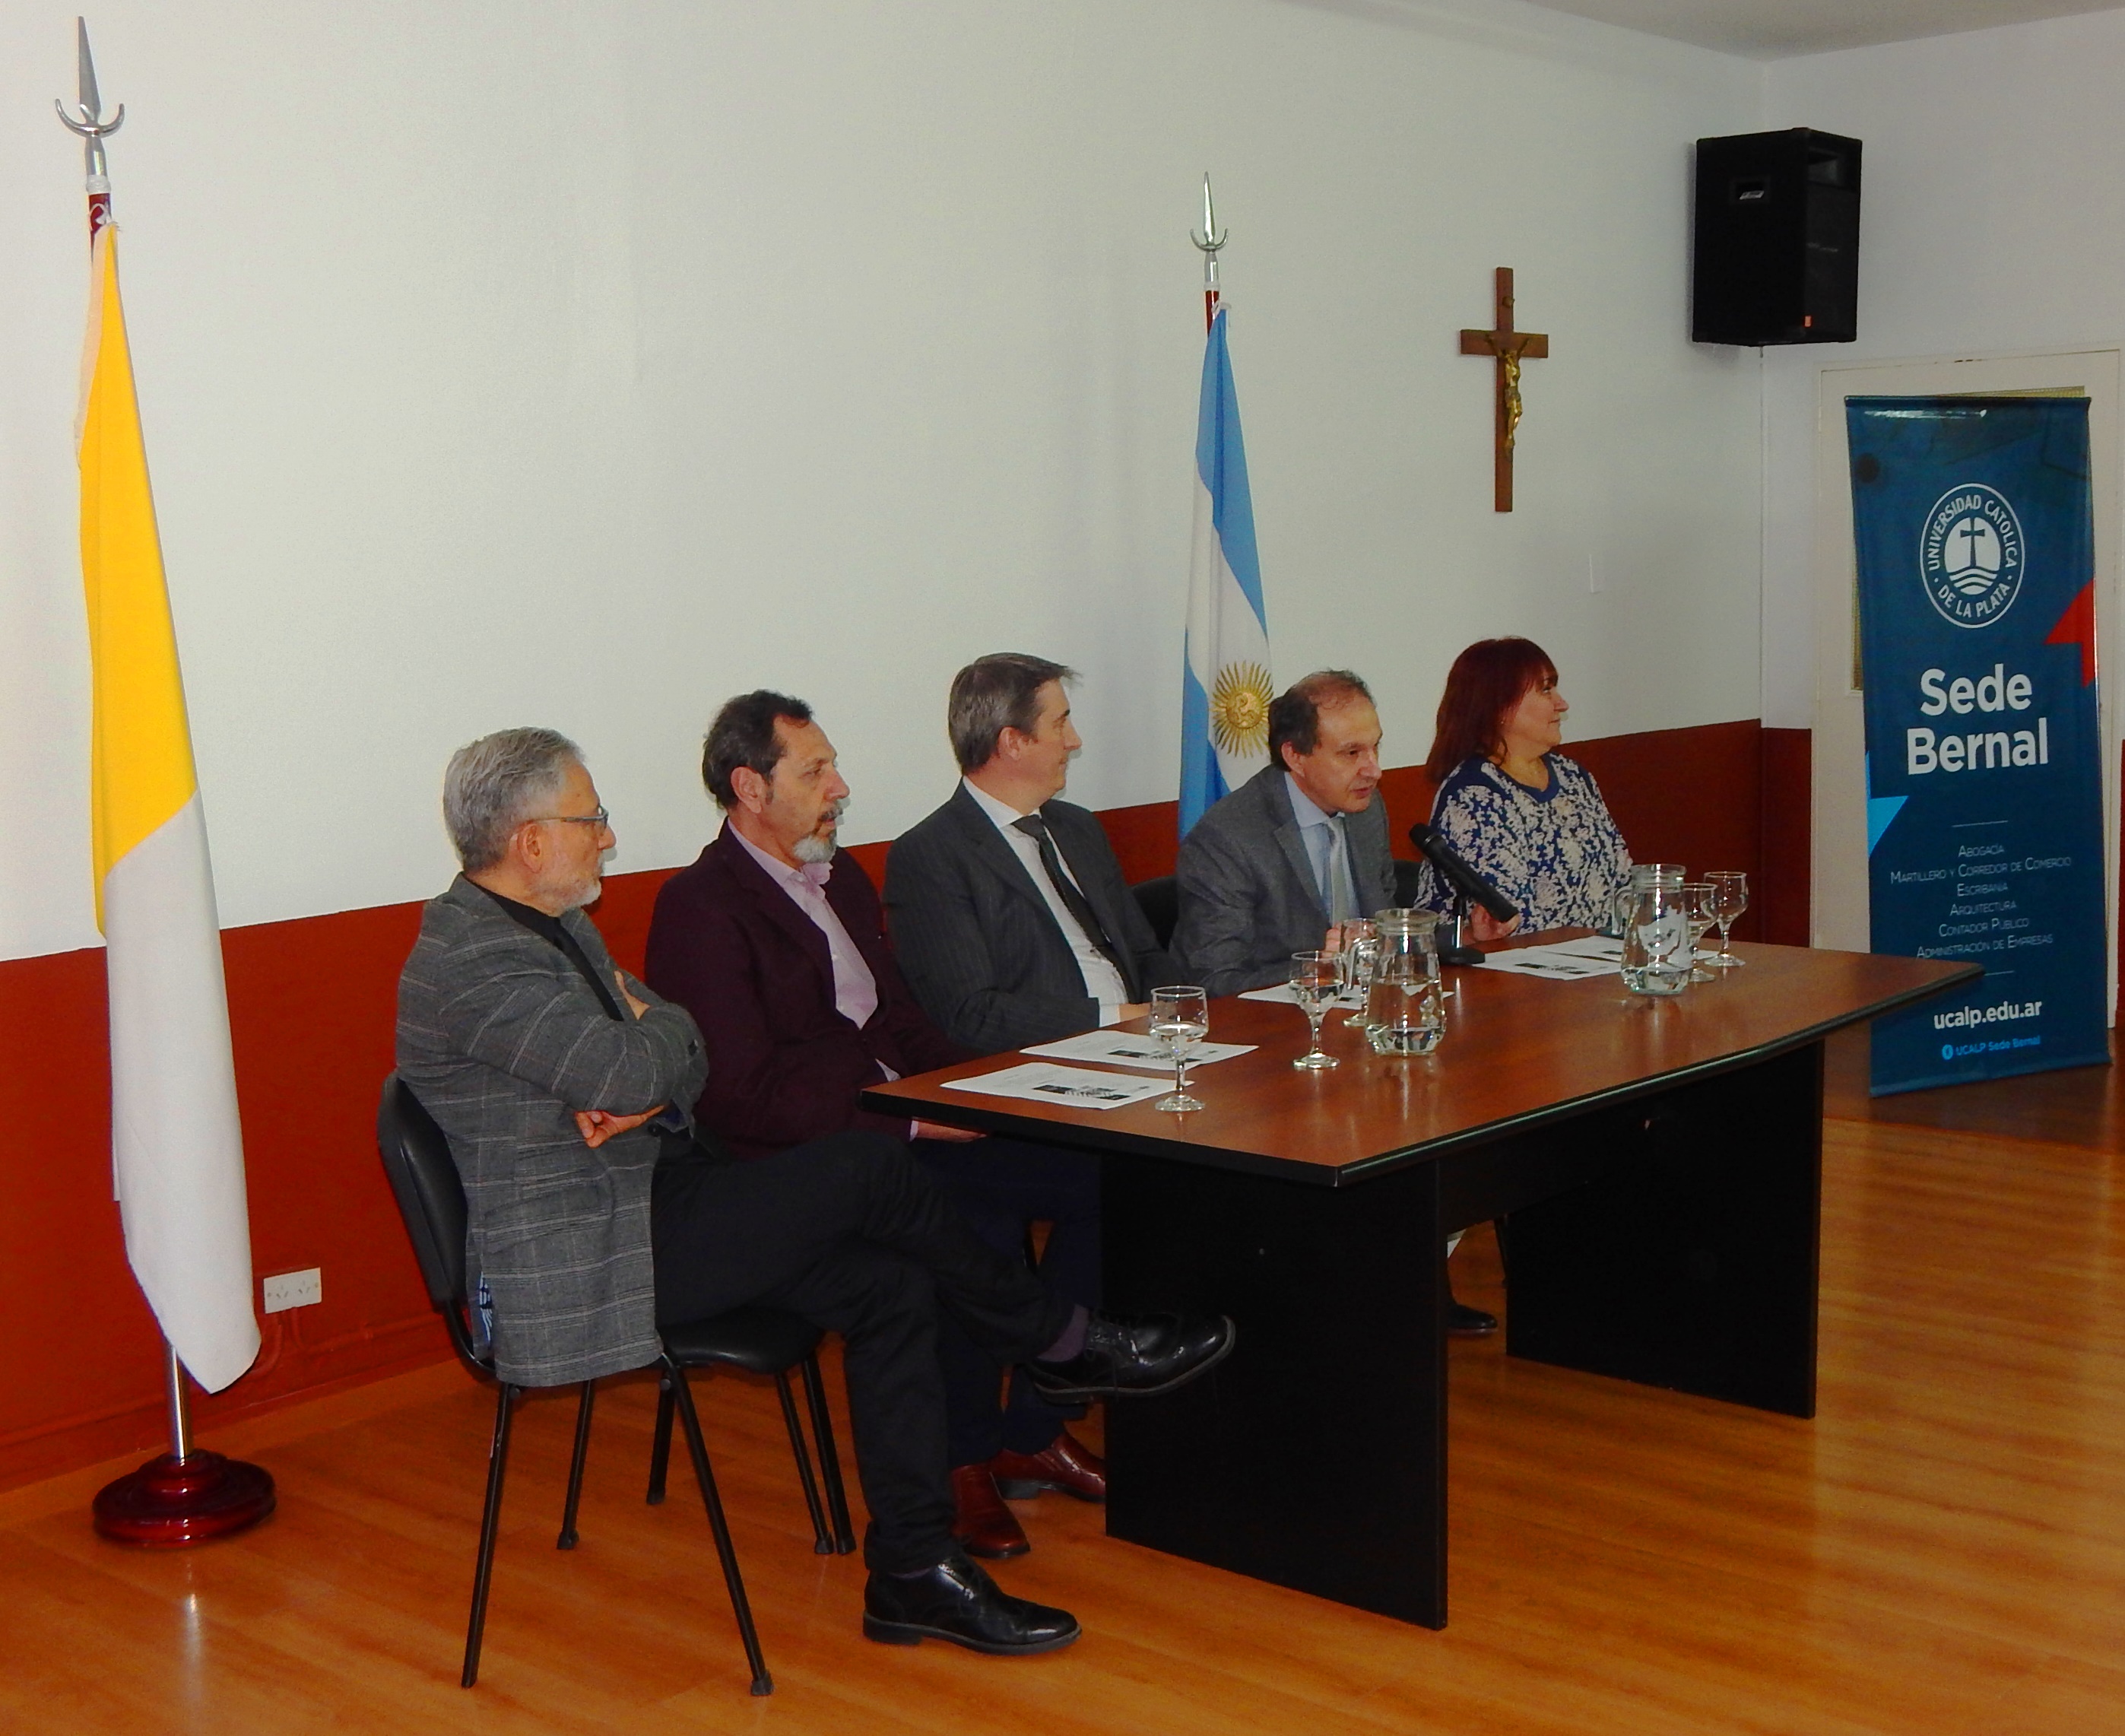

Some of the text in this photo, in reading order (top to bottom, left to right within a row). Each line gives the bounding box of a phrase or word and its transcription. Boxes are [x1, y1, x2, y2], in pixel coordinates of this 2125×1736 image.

[1928, 494, 2017, 570] UNIVERSIDAD CATOLICA
[1938, 582, 2010, 617] DE LA PLATA
[1920, 663, 2032, 716] Sede
[1907, 717, 2048, 775] Bernal
[1890, 869, 1947, 884] MARTILLERO
[1958, 863, 2008, 878] CORREDOR
[2010, 862, 2022, 872] DE
[2025, 857, 2072, 871] COMERCIO
[1949, 900, 2016, 916] ARQUITECTURA
[1939, 922, 1988, 937] CONTADOR
[1993, 939, 2005, 951] DE
[2007, 934, 2054, 949] EMPRESAS
[1934, 1001, 2042, 1029] ucalp.edu.ar
[1955, 1035, 2041, 1056] UCALP Sede Bernal
